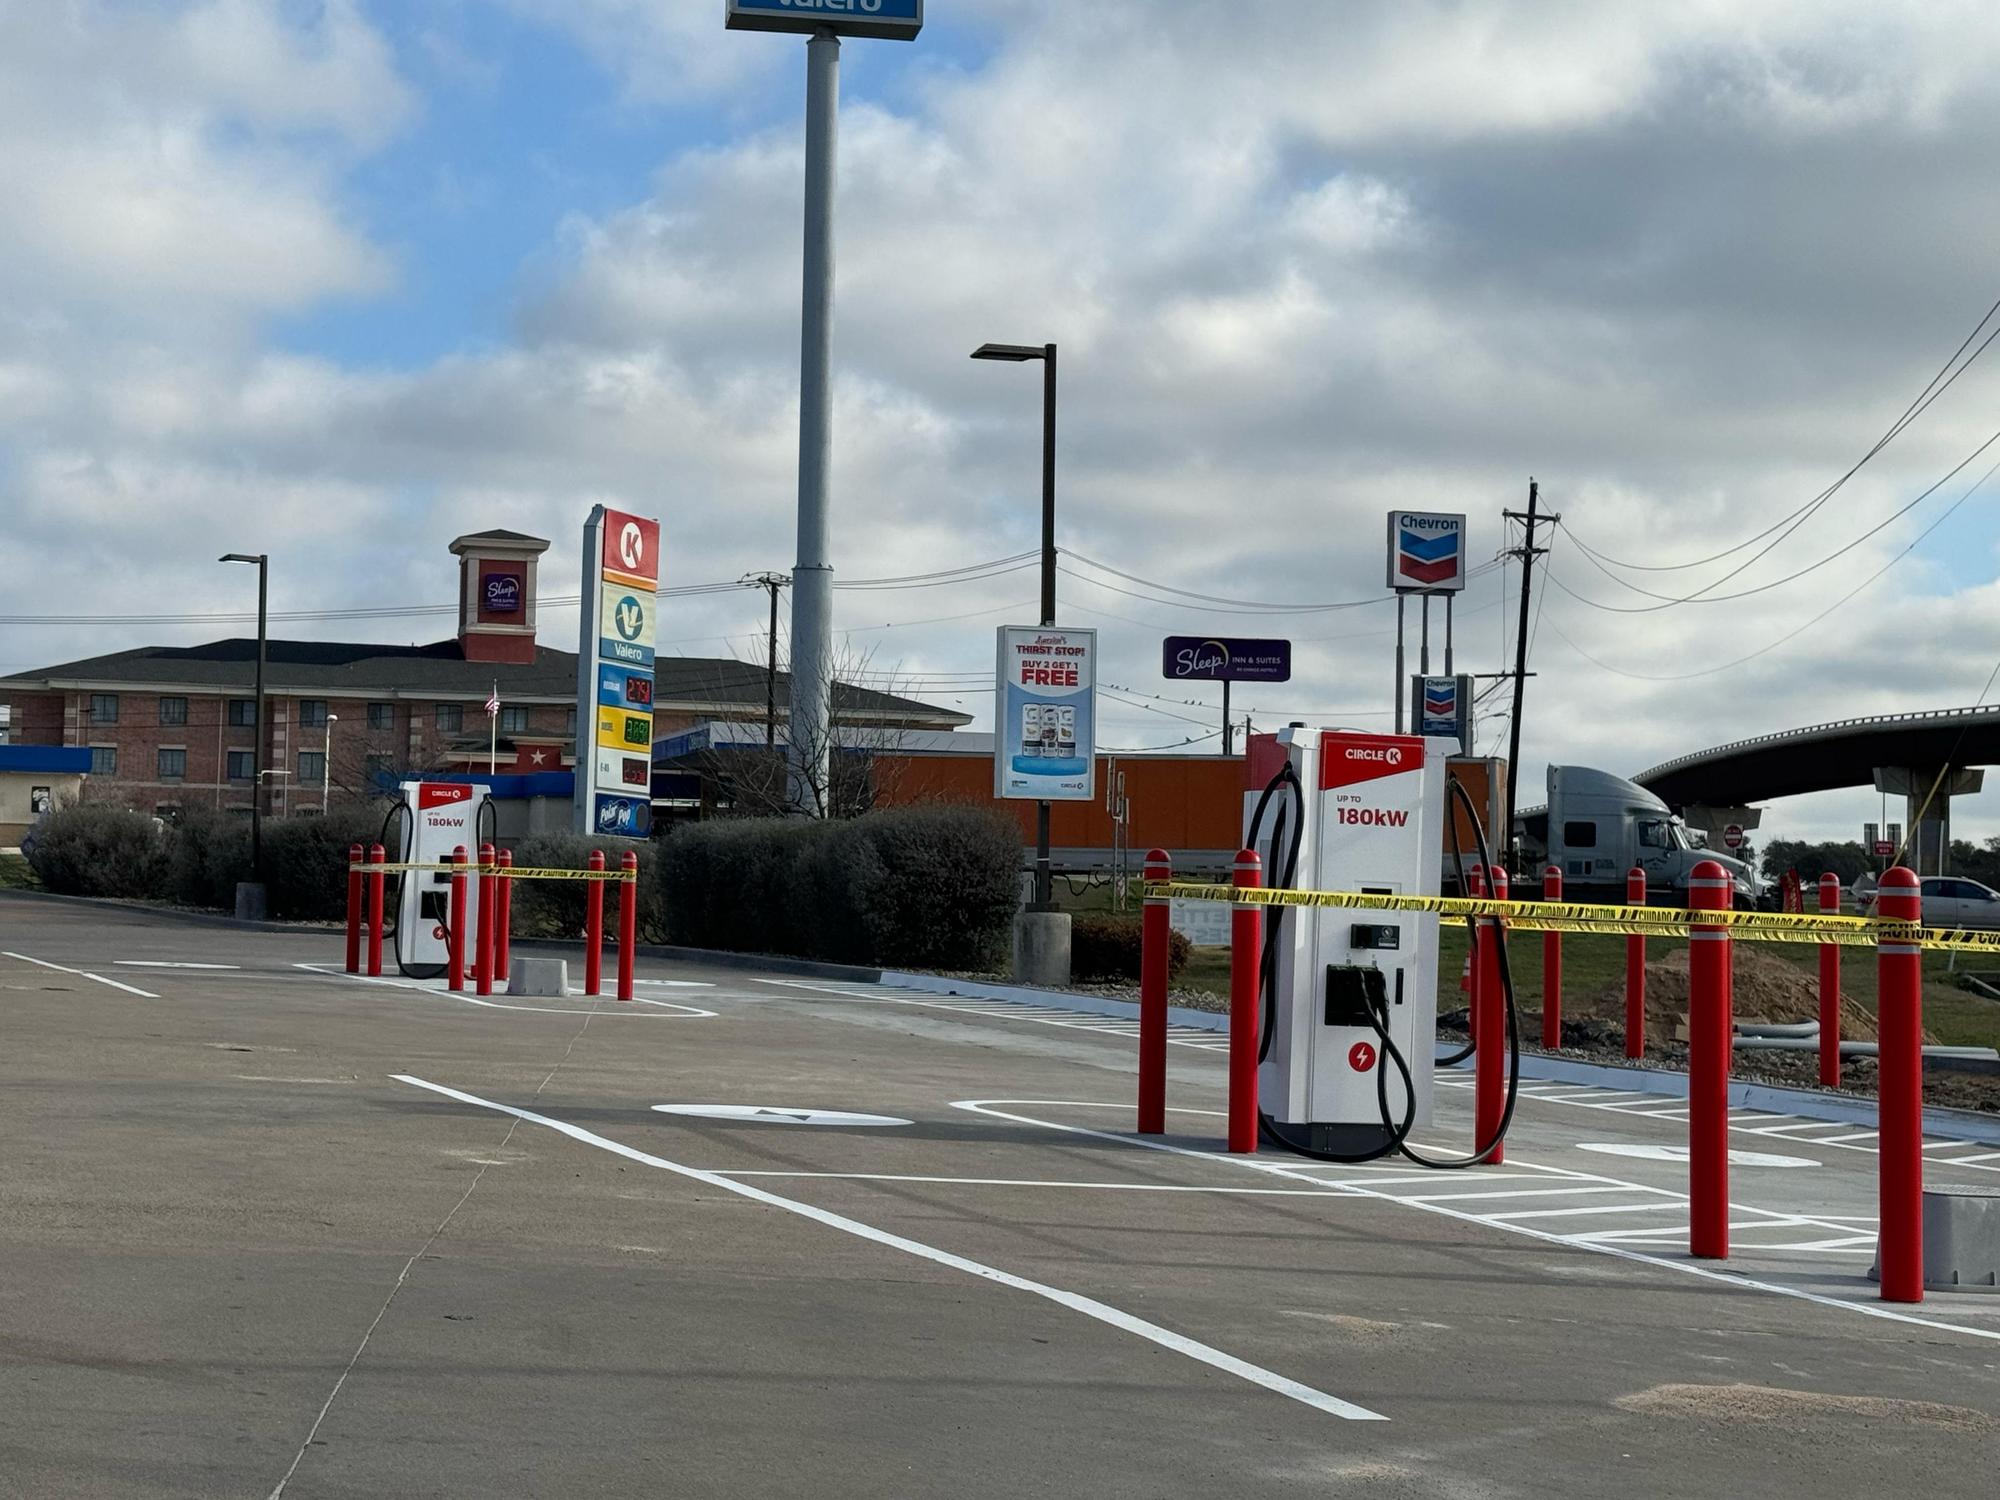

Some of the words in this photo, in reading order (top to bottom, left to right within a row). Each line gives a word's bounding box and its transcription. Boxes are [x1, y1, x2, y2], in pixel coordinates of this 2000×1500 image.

[1401, 514, 1459, 530] Chevron
[487, 582, 515, 597] Sleep
[614, 642, 642, 660] Valero
[1016, 645, 1053, 655] THIRST
[1055, 646, 1086, 657] STOP!
[1022, 660, 1041, 668] BUY
[1052, 661, 1071, 669] GET
[1176, 648, 1225, 675] Sleep
[1232, 656, 1247, 664] INN
[1256, 656, 1281, 664] SUITES
[1021, 669, 1079, 687] FREE
[1345, 749, 1385, 761] CIRCLE
[1337, 794, 1349, 802] UP
[1350, 795, 1361, 803] TO
[428, 818, 464, 827] 180kW
[600, 804, 617, 824] Polar
[617, 808, 631, 826] Pop
[1337, 807, 1409, 827] 180kW
[1488, 902, 1516, 914] CAUTION
[1585, 907, 1616, 918] CAUTION
[1639, 911, 1671, 922] CUIDADO
[1694, 912, 1728, 923] CAUTION
